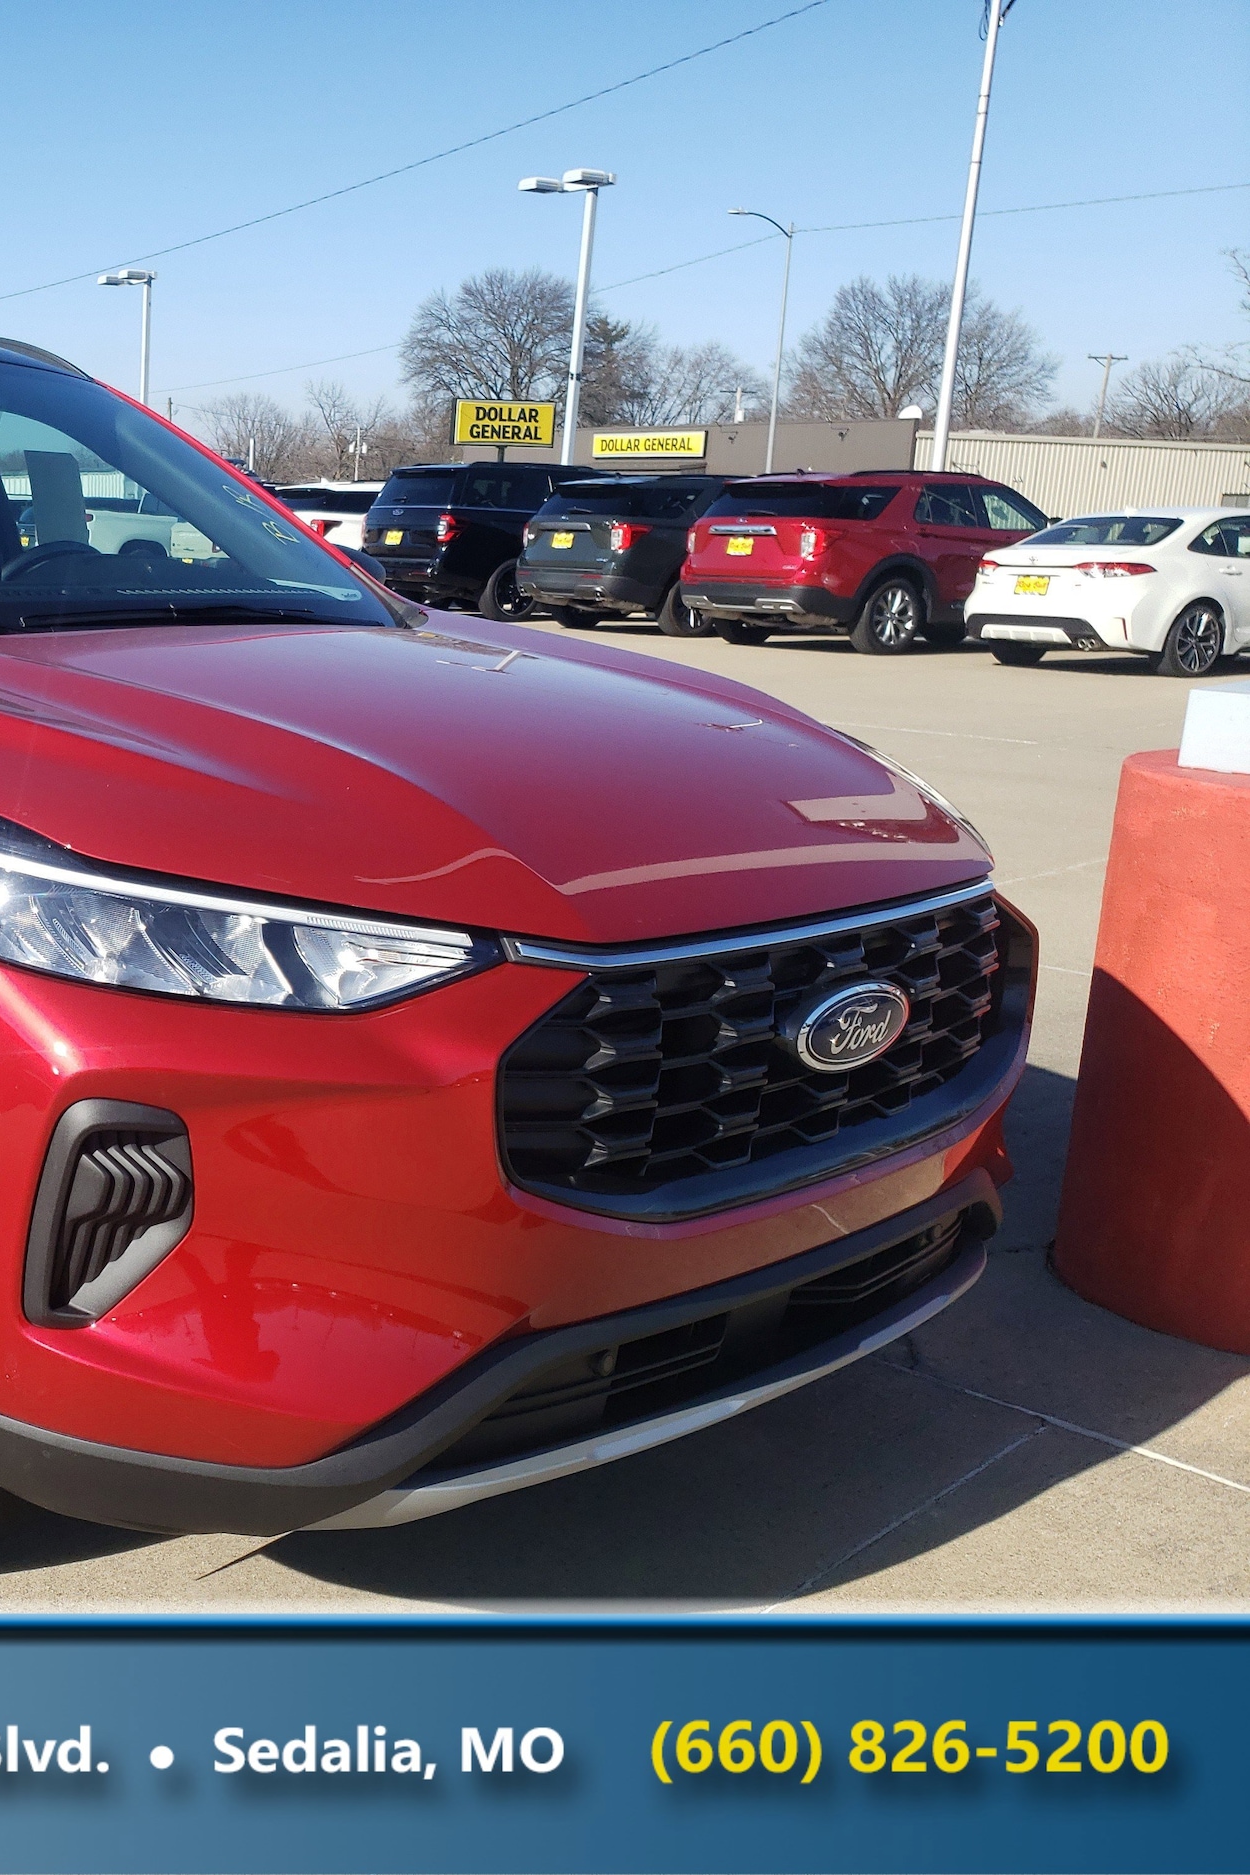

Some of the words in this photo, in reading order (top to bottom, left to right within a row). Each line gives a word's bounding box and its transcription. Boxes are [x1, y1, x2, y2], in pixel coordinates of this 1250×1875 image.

[475, 406, 540, 424] DOLLAR
[469, 424, 543, 442] GENERAL
[600, 439, 640, 452] DOLLAR
[643, 437, 693, 451] GENERAL
[830, 1003, 892, 1055] Ford
